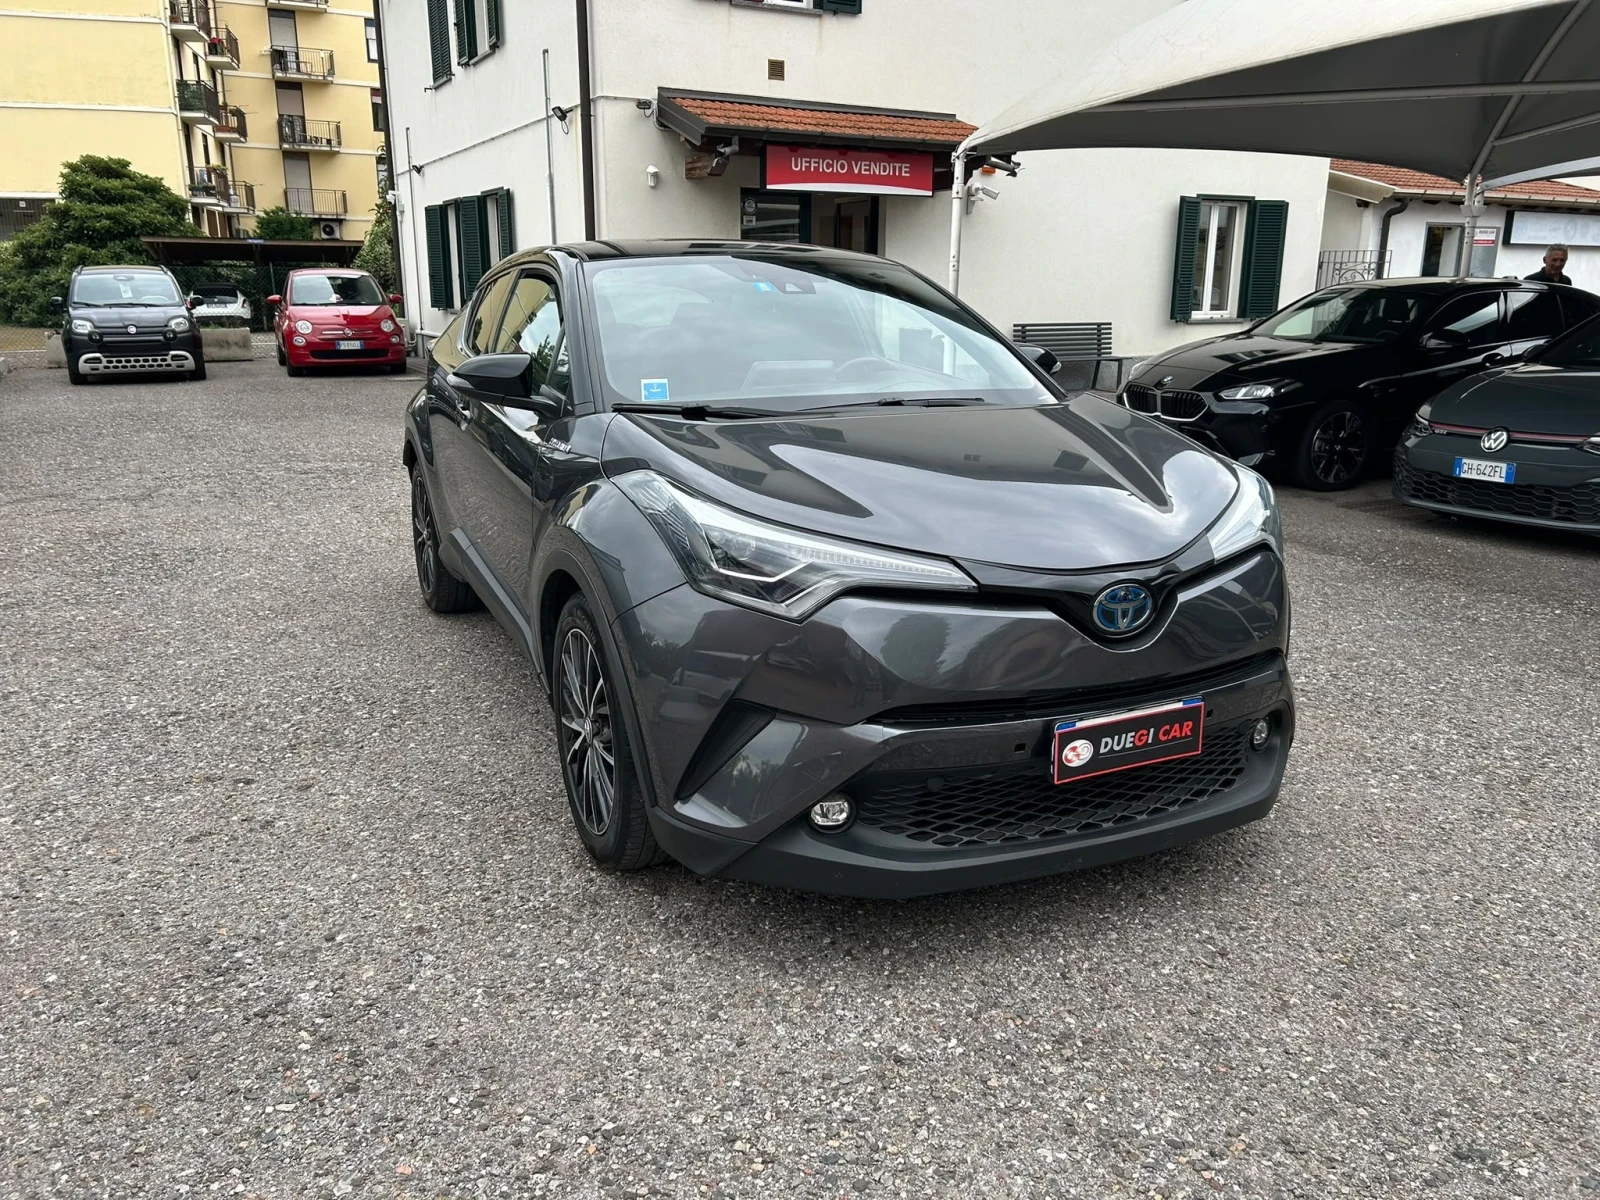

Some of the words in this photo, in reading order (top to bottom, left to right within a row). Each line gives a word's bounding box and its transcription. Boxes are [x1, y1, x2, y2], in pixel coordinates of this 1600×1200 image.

[791, 157, 848, 173] UFFICIO
[852, 161, 910, 176] VENDITE
[1100, 728, 1154, 753] DUEGI
[1158, 721, 1193, 741] CAR
